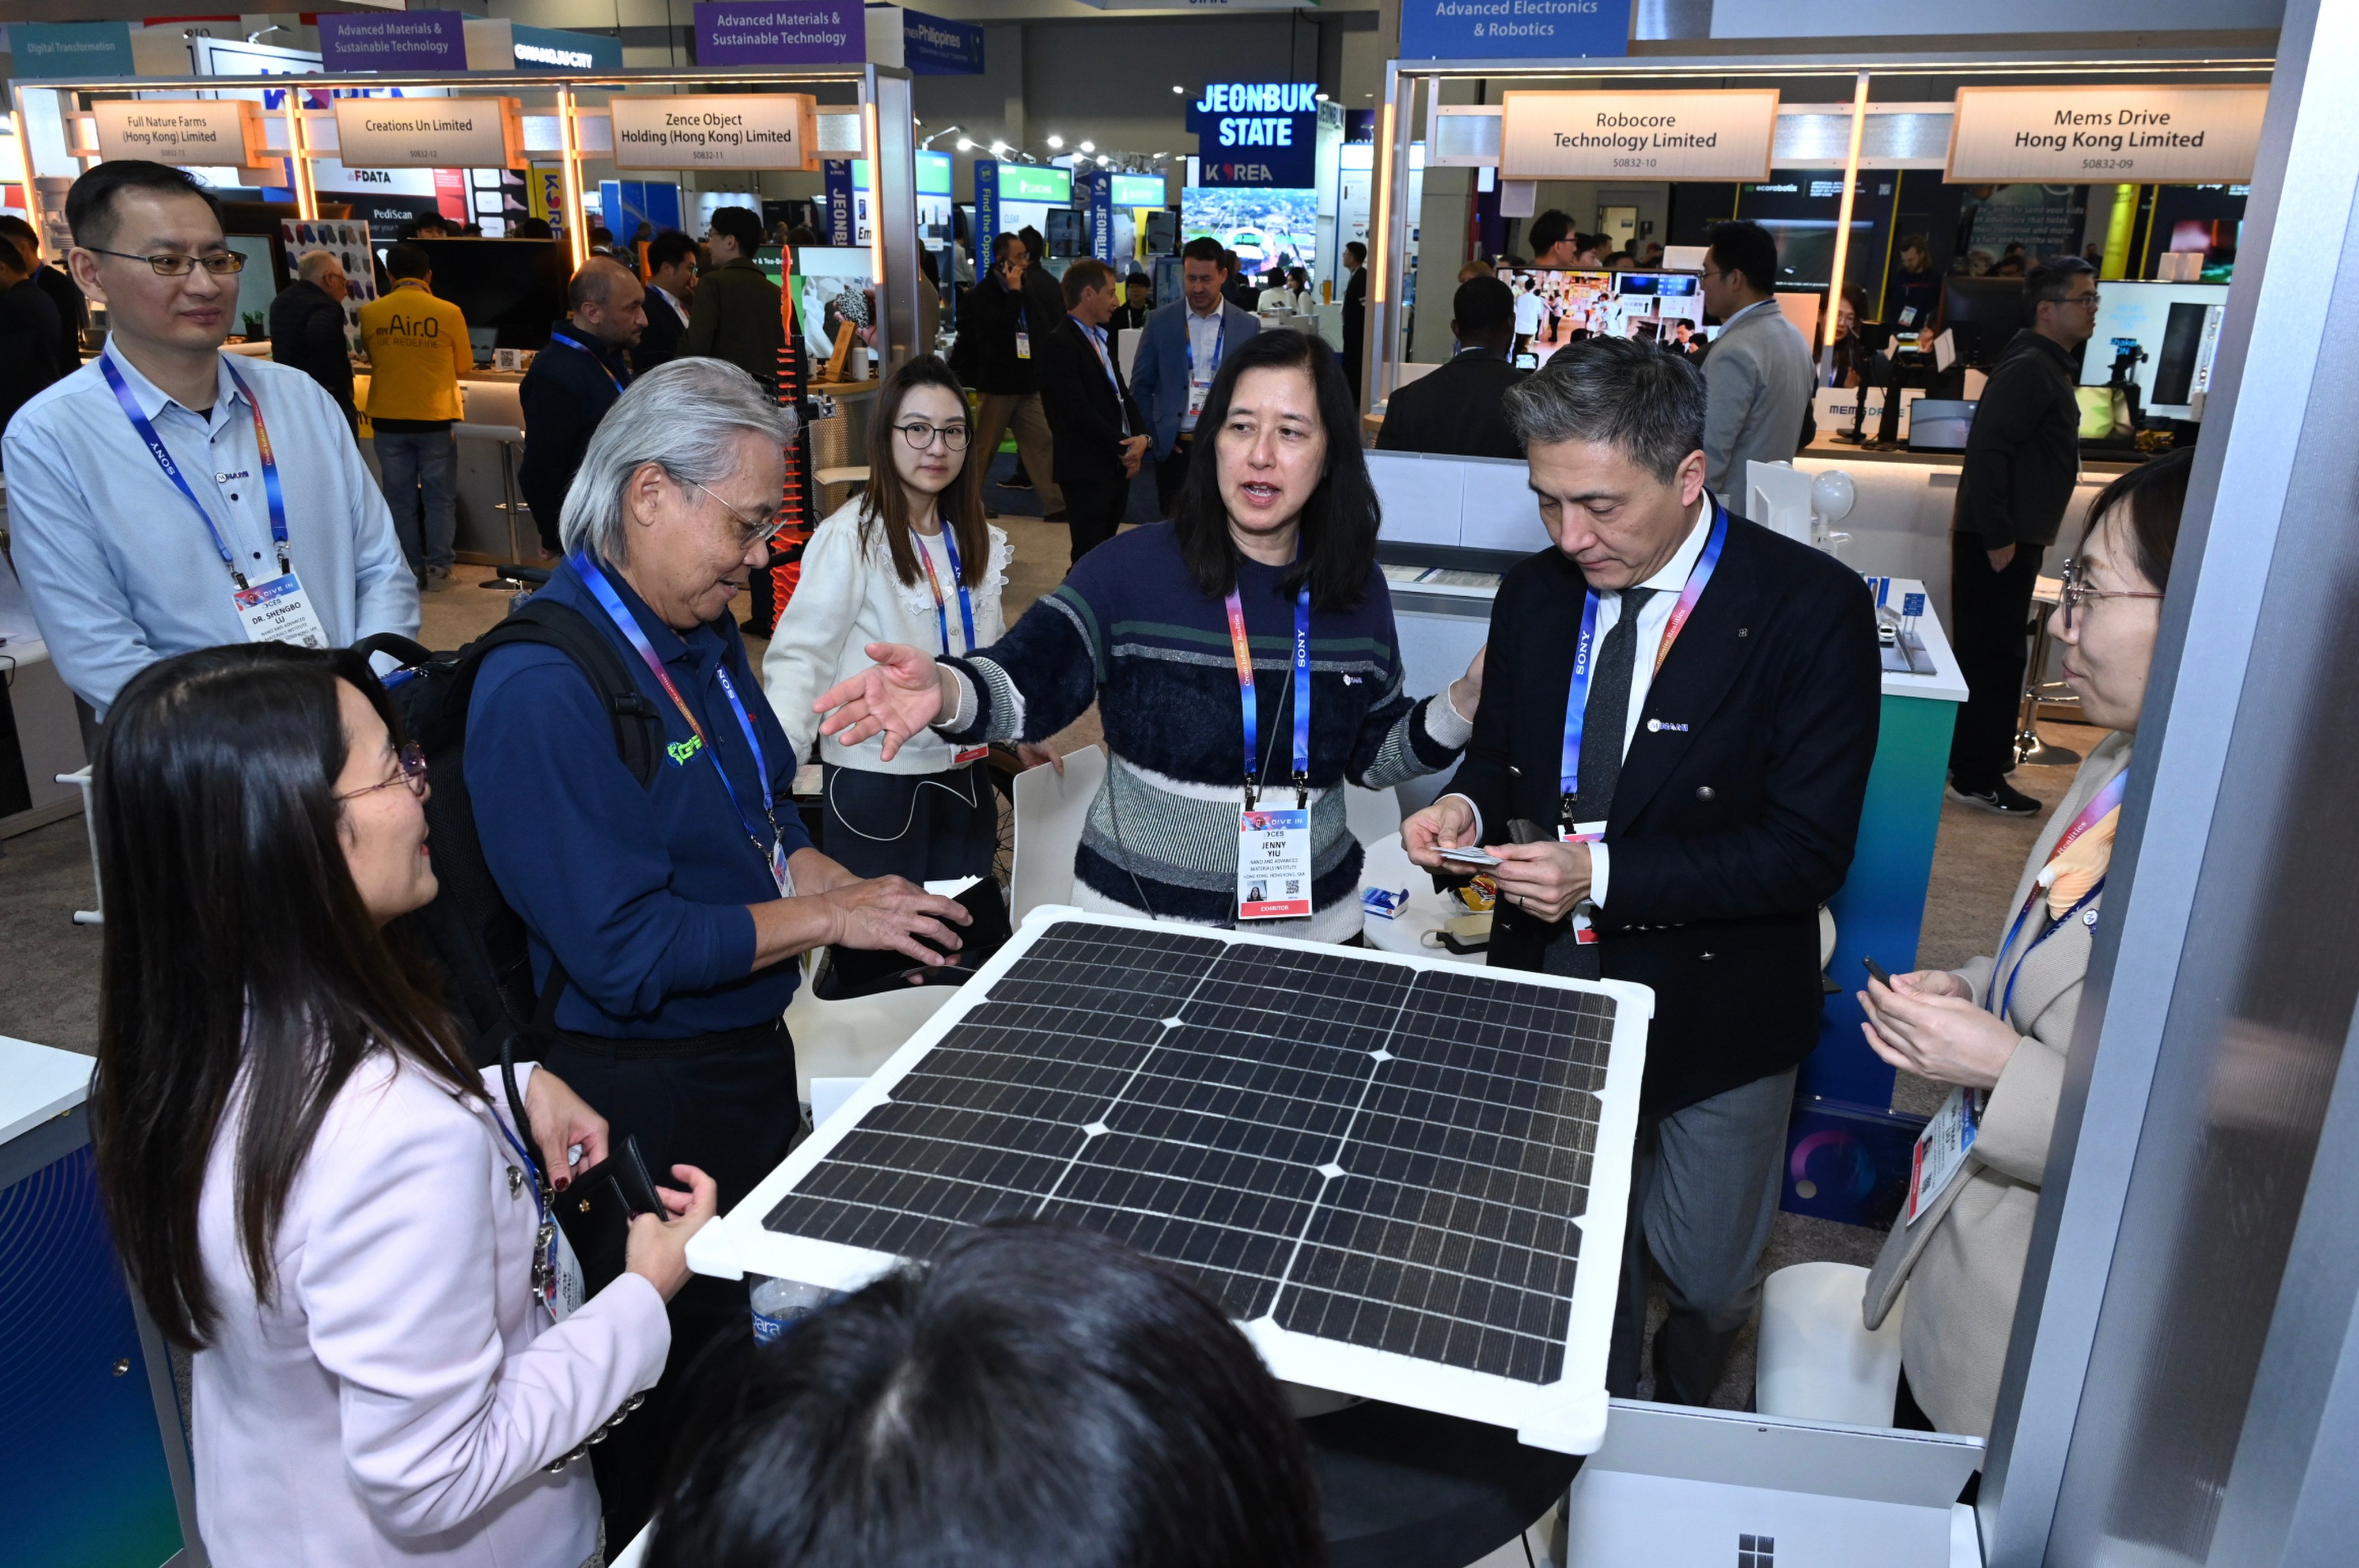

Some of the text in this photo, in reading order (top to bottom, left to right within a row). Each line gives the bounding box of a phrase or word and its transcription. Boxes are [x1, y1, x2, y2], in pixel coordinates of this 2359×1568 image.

[1436, 0, 1597, 16] Advanced Electronics
[718, 12, 840, 26] Advanced Materials &
[338, 22, 442, 35] Advanced Materials &
[918, 24, 960, 48] Philippines
[1474, 22, 1554, 36] & Robotics
[713, 32, 846, 46] Sustainable Technology
[28, 42, 115, 55] Digital Transformation
[335, 40, 449, 54] Sustainable Technology
[1196, 84, 1318, 113] JEONBUK
[128, 116, 206, 127] Full Nature Farms
[666, 113, 743, 128] Zence Object
[1596, 113, 1676, 127] Robocore
[2054, 109, 2171, 126] Mems Drive
[366, 119, 472, 132] Creations Un Limited
[1219, 118, 1293, 146] STATE
[123, 131, 217, 145] (Hong Kong) Limited
[622, 130, 791, 146] Holding (Hong Kong) Limited
[1554, 132, 1717, 151] Technology Limited
[2015, 131, 2205, 152] Hong Kong Limited
[693, 151, 724, 160] 50832-11
[1613, 158, 1657, 168] 50832-10
[2082, 159, 2133, 169] 50832-09
[354, 170, 391, 184] FDATA
[1206, 164, 1274, 181] KOREA
[374, 209, 412, 220] PediScan
[544, 175, 563, 239] KORE
[832, 188, 847, 245] JEONB
[858, 226, 872, 240] Em
[982, 188, 992, 278] Find the Oppor
[150, 442, 176, 476] SONY
[252, 601, 301, 625] DR. SHENGBO
[275, 616, 286, 625] LU
[1667, 608, 1686, 639] Realities
[1297, 628, 1307, 668] SONY
[1575, 630, 1590, 675] SONY
[716, 663, 735, 700] SON
[2057, 820, 2087, 855] Realities
[1262, 841, 1286, 850] JENNY
